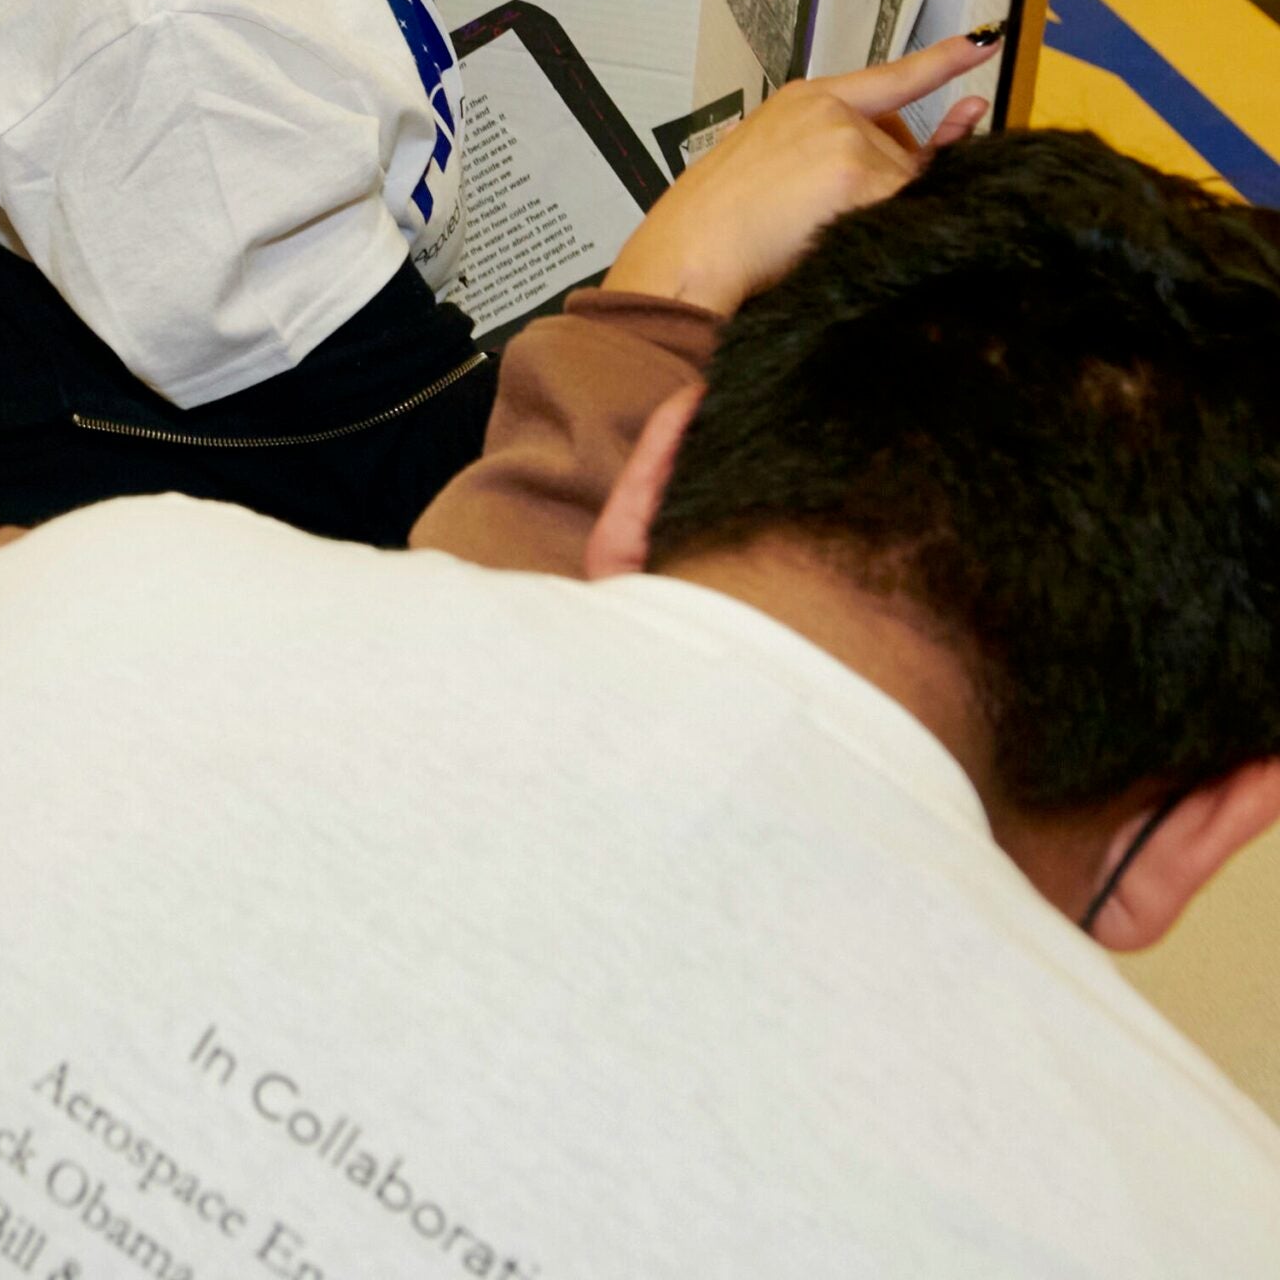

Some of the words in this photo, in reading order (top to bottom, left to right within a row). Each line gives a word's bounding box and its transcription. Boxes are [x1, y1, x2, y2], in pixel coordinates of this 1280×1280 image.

[469, 94, 487, 108] then
[475, 106, 489, 120] and
[467, 132, 499, 153] because
[472, 152, 488, 165] that
[490, 143, 507, 156] area
[507, 137, 516, 145] to
[471, 162, 500, 181] outside
[501, 155, 512, 164] we
[466, 195, 494, 213] boiling
[494, 186, 507, 197] hot
[509, 174, 529, 189] water
[476, 178, 498, 193] When
[500, 171, 510, 180] we
[467, 217, 479, 228] the
[31, 1060, 246, 1239] Aerospace
[185, 1023, 237, 1086] In
[252, 1072, 542, 1280] Collaborat
